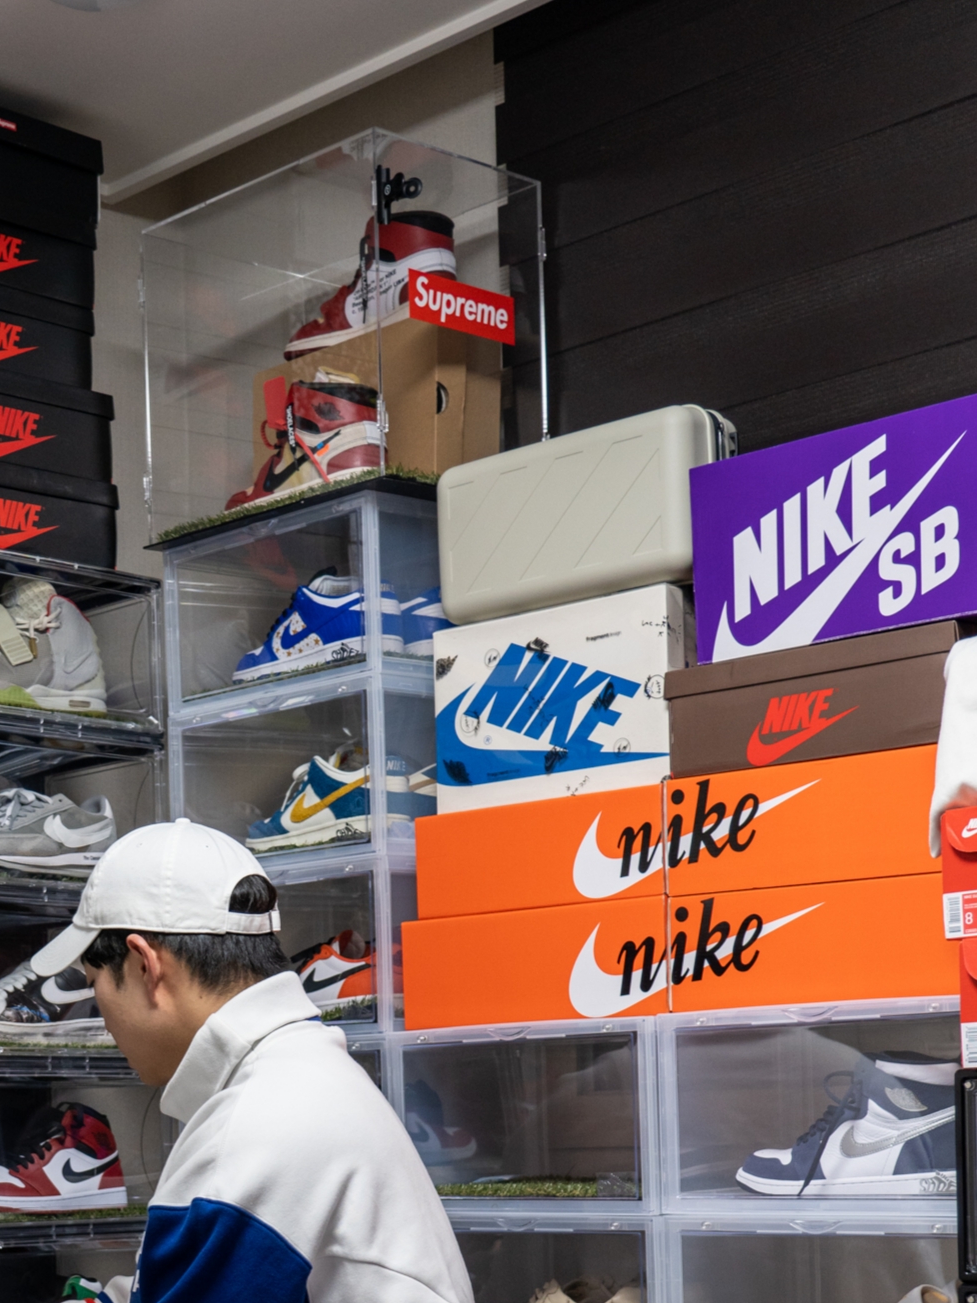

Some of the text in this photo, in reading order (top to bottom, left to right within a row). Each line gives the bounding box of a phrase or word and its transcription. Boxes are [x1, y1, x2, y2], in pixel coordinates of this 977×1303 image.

[414, 275, 509, 330] Supreme
[733, 433, 891, 624] NIKE
[878, 505, 961, 617] SB
[463, 642, 642, 753] NIKE
[761, 688, 834, 735] NIKE
[617, 778, 759, 878] nike
[617, 897, 763, 996] nike
